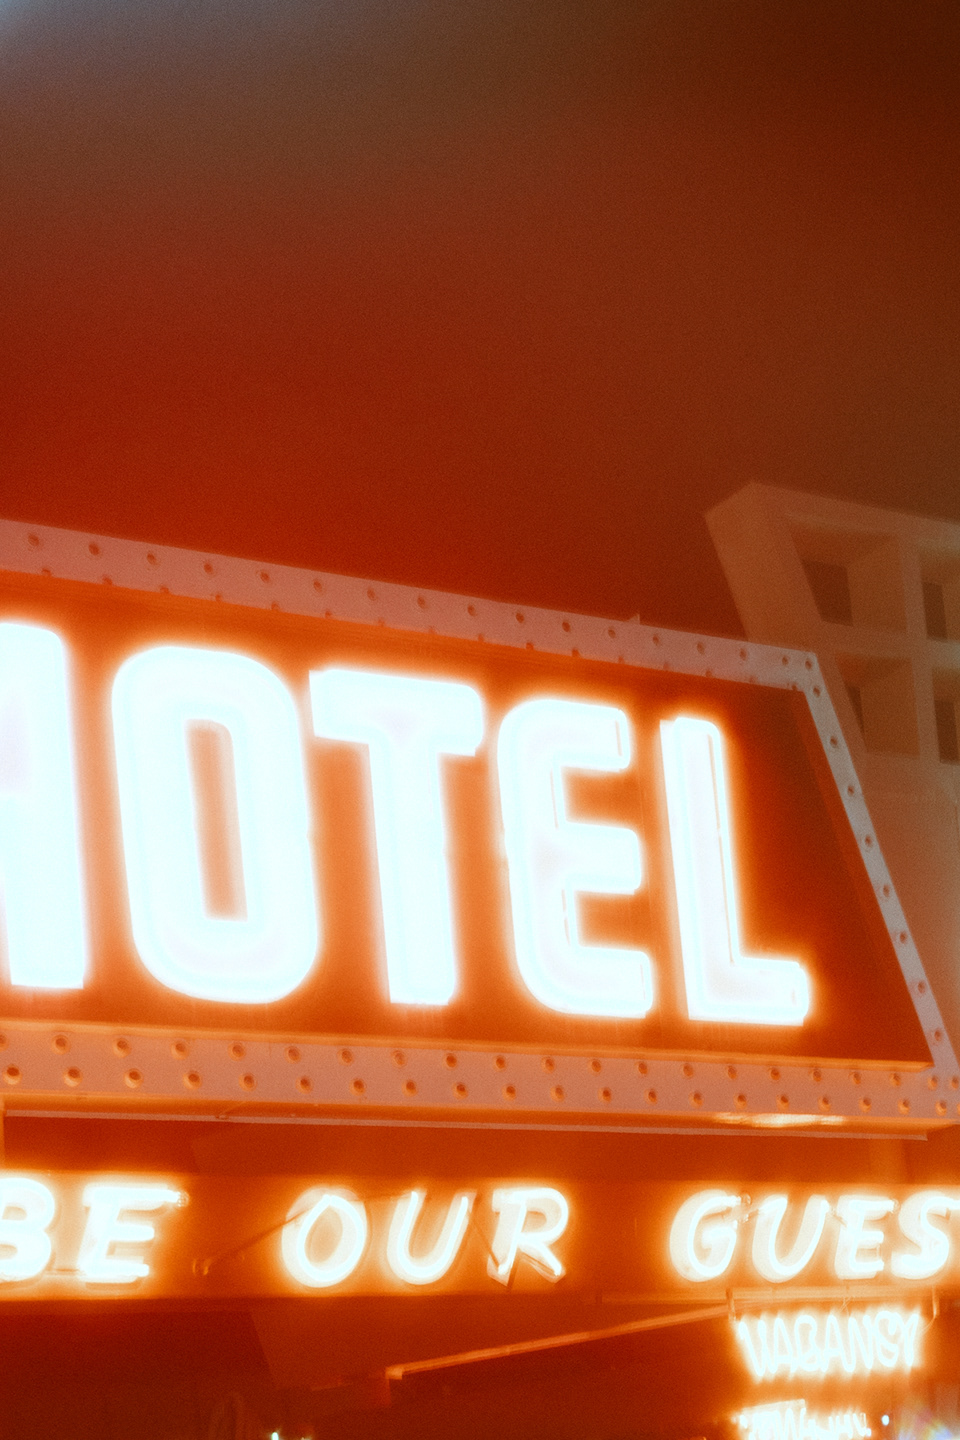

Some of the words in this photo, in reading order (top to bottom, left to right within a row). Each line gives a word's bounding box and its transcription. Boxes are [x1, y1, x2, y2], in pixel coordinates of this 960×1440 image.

[0, 1176, 184, 1285] BE
[281, 1186, 570, 1289] OUR
[735, 1307, 921, 1380] VACANCY
